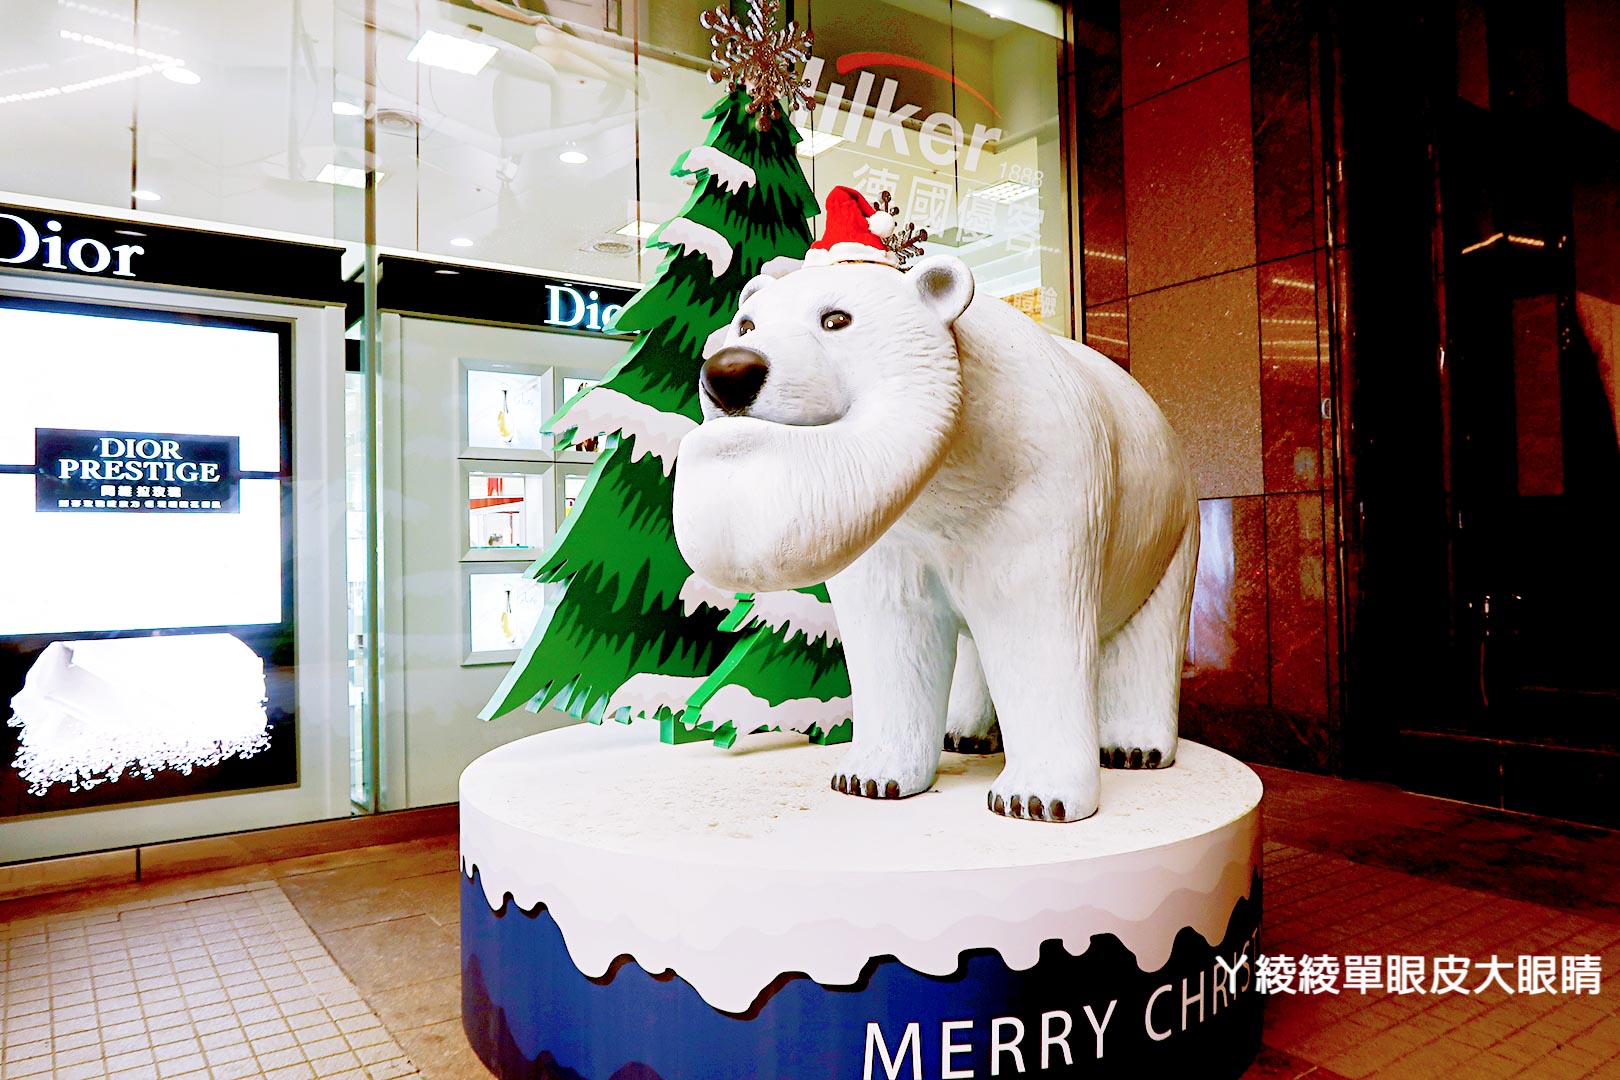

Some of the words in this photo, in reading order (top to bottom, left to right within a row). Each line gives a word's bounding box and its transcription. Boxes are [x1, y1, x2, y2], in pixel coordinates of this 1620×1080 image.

[999, 161, 1045, 188] 1888
[0, 213, 144, 277] Dior
[99, 437, 182, 460] DIOR
[58, 458, 220, 483] PRESTIGE
[863, 999, 1118, 1080] MERRY
